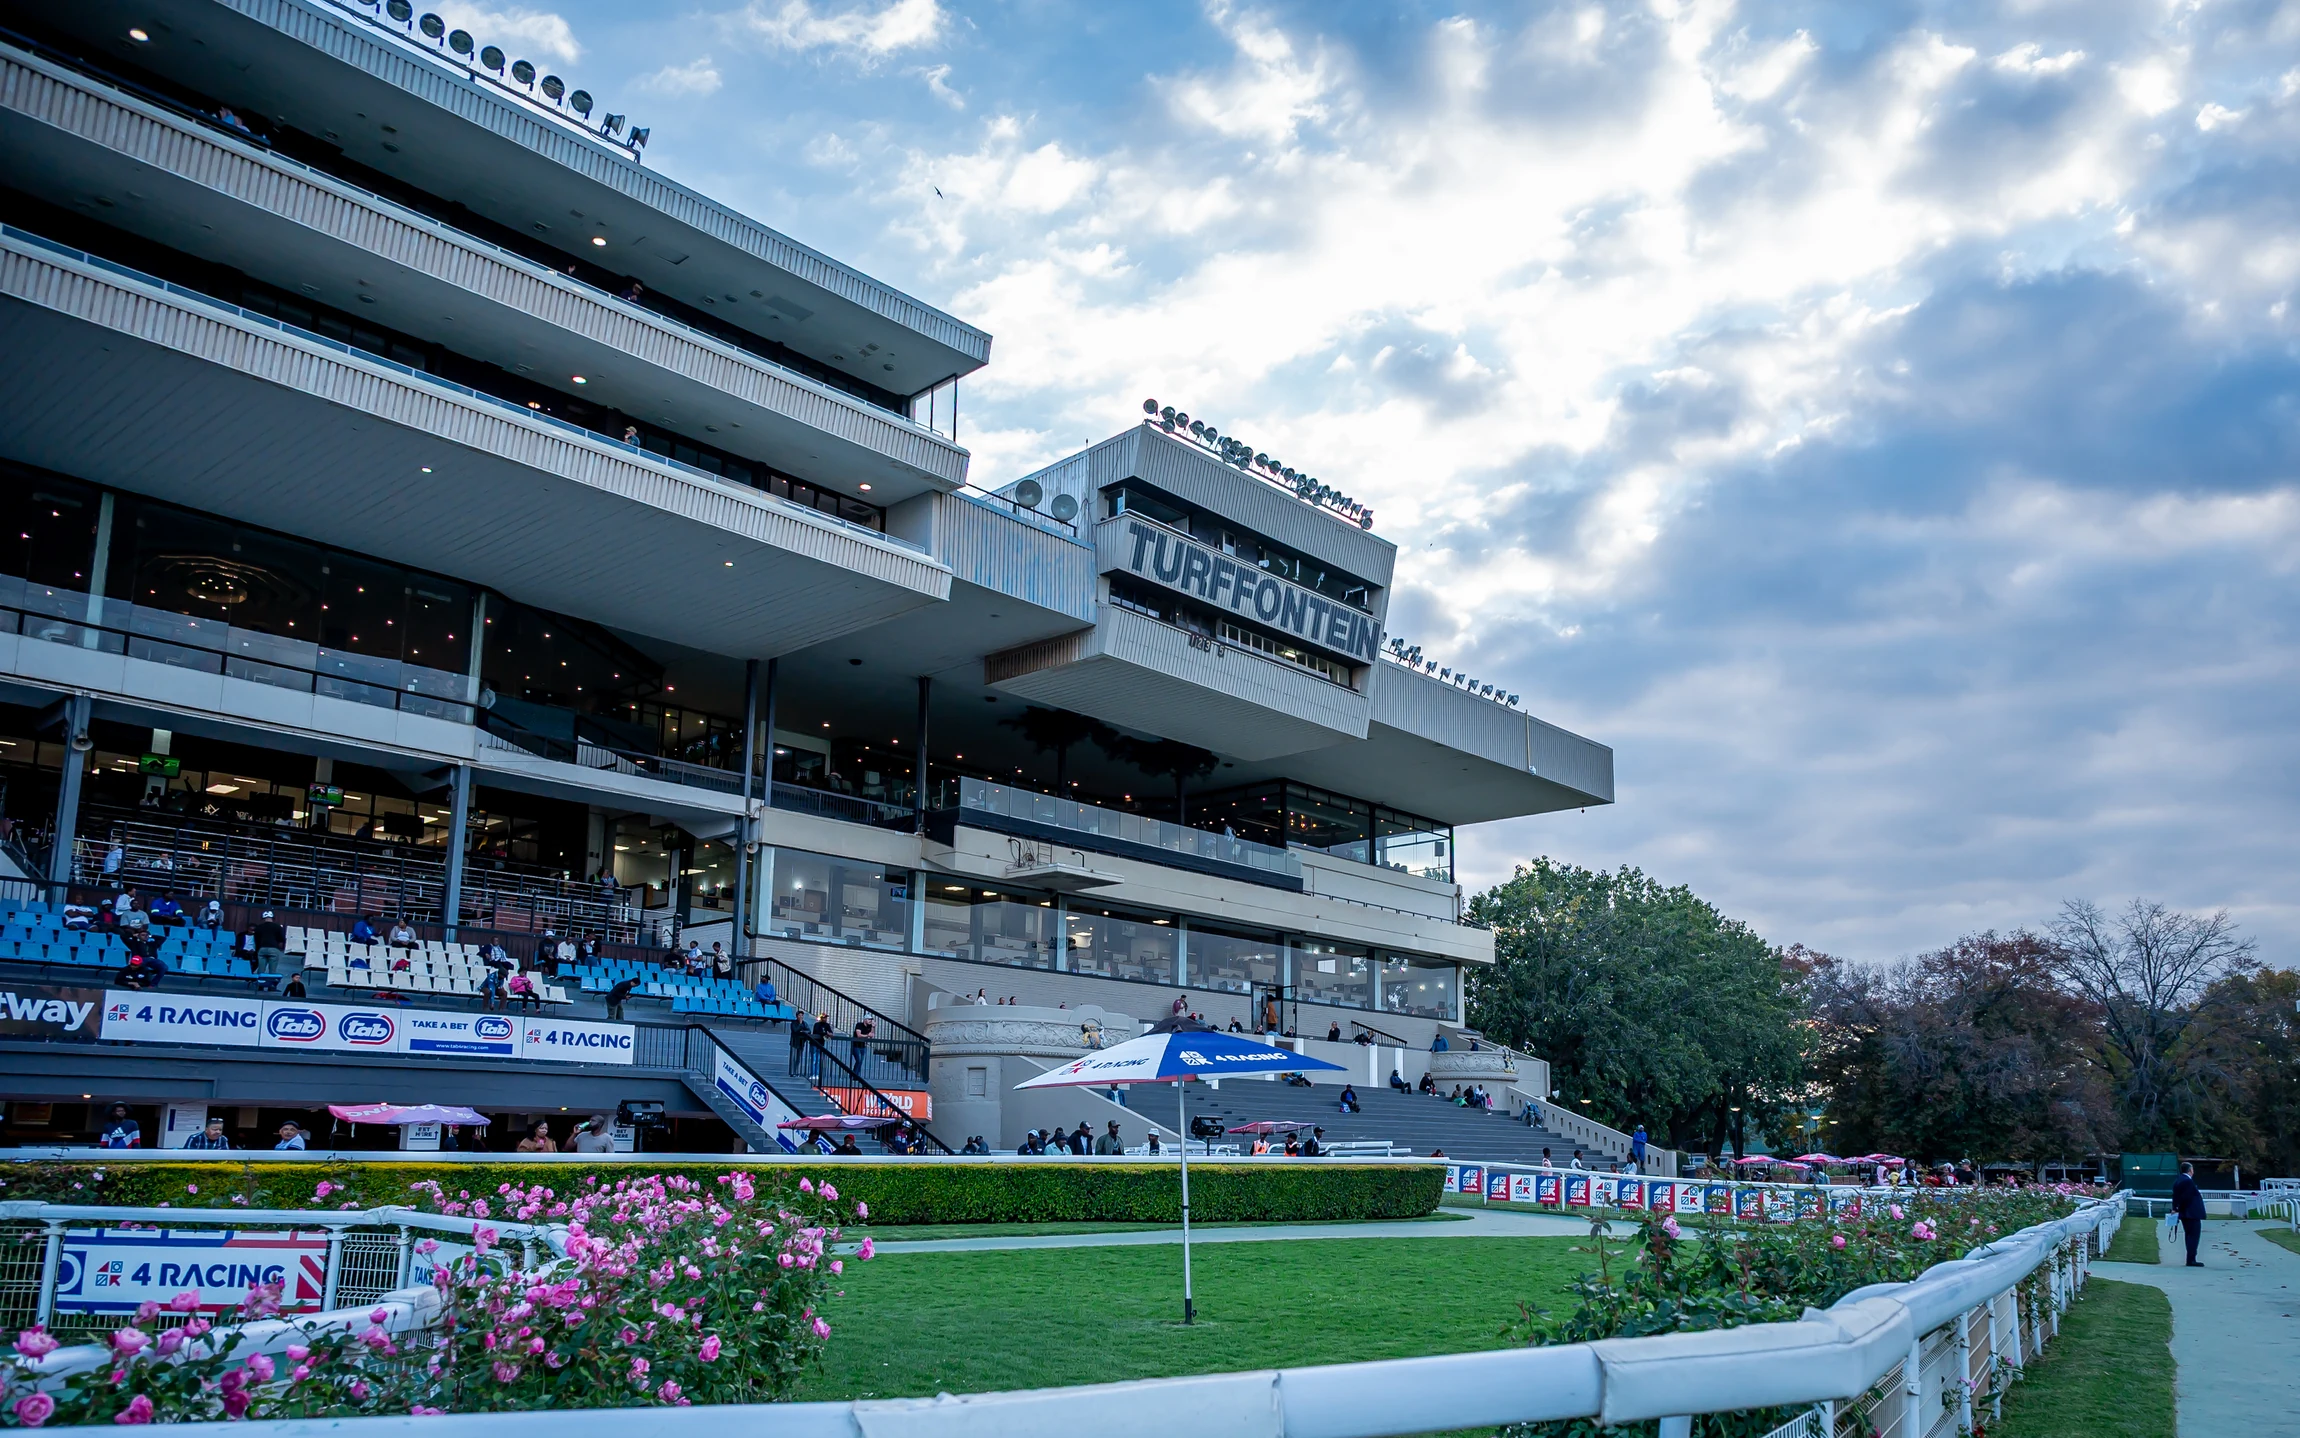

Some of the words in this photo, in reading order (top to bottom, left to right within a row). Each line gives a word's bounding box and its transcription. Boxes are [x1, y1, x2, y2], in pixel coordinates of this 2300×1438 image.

[1128, 521, 1381, 662] TURFFONTEIN
[135, 1005, 153, 1023] 4
[159, 1006, 257, 1028] RACING
[275, 1015, 320, 1034] tab
[412, 1020, 438, 1029] TAKE
[440, 1021, 448, 1029] A
[450, 1021, 468, 1031] BET
[346, 1019, 389, 1038] tab
[479, 1020, 510, 1035] tab
[545, 1030, 558, 1045] 4
[562, 1031, 631, 1049] RACING
[1098, 1057, 1150, 1070] RACING
[1215, 1054, 1227, 1062] 4
[1224, 1052, 1288, 1062] RACING
[722, 1061, 735, 1076] TAKE
[738, 1075, 749, 1088] BET
[751, 1087, 766, 1106] tab
[131, 1262, 152, 1287] 4
[158, 1262, 286, 1289] RACING
